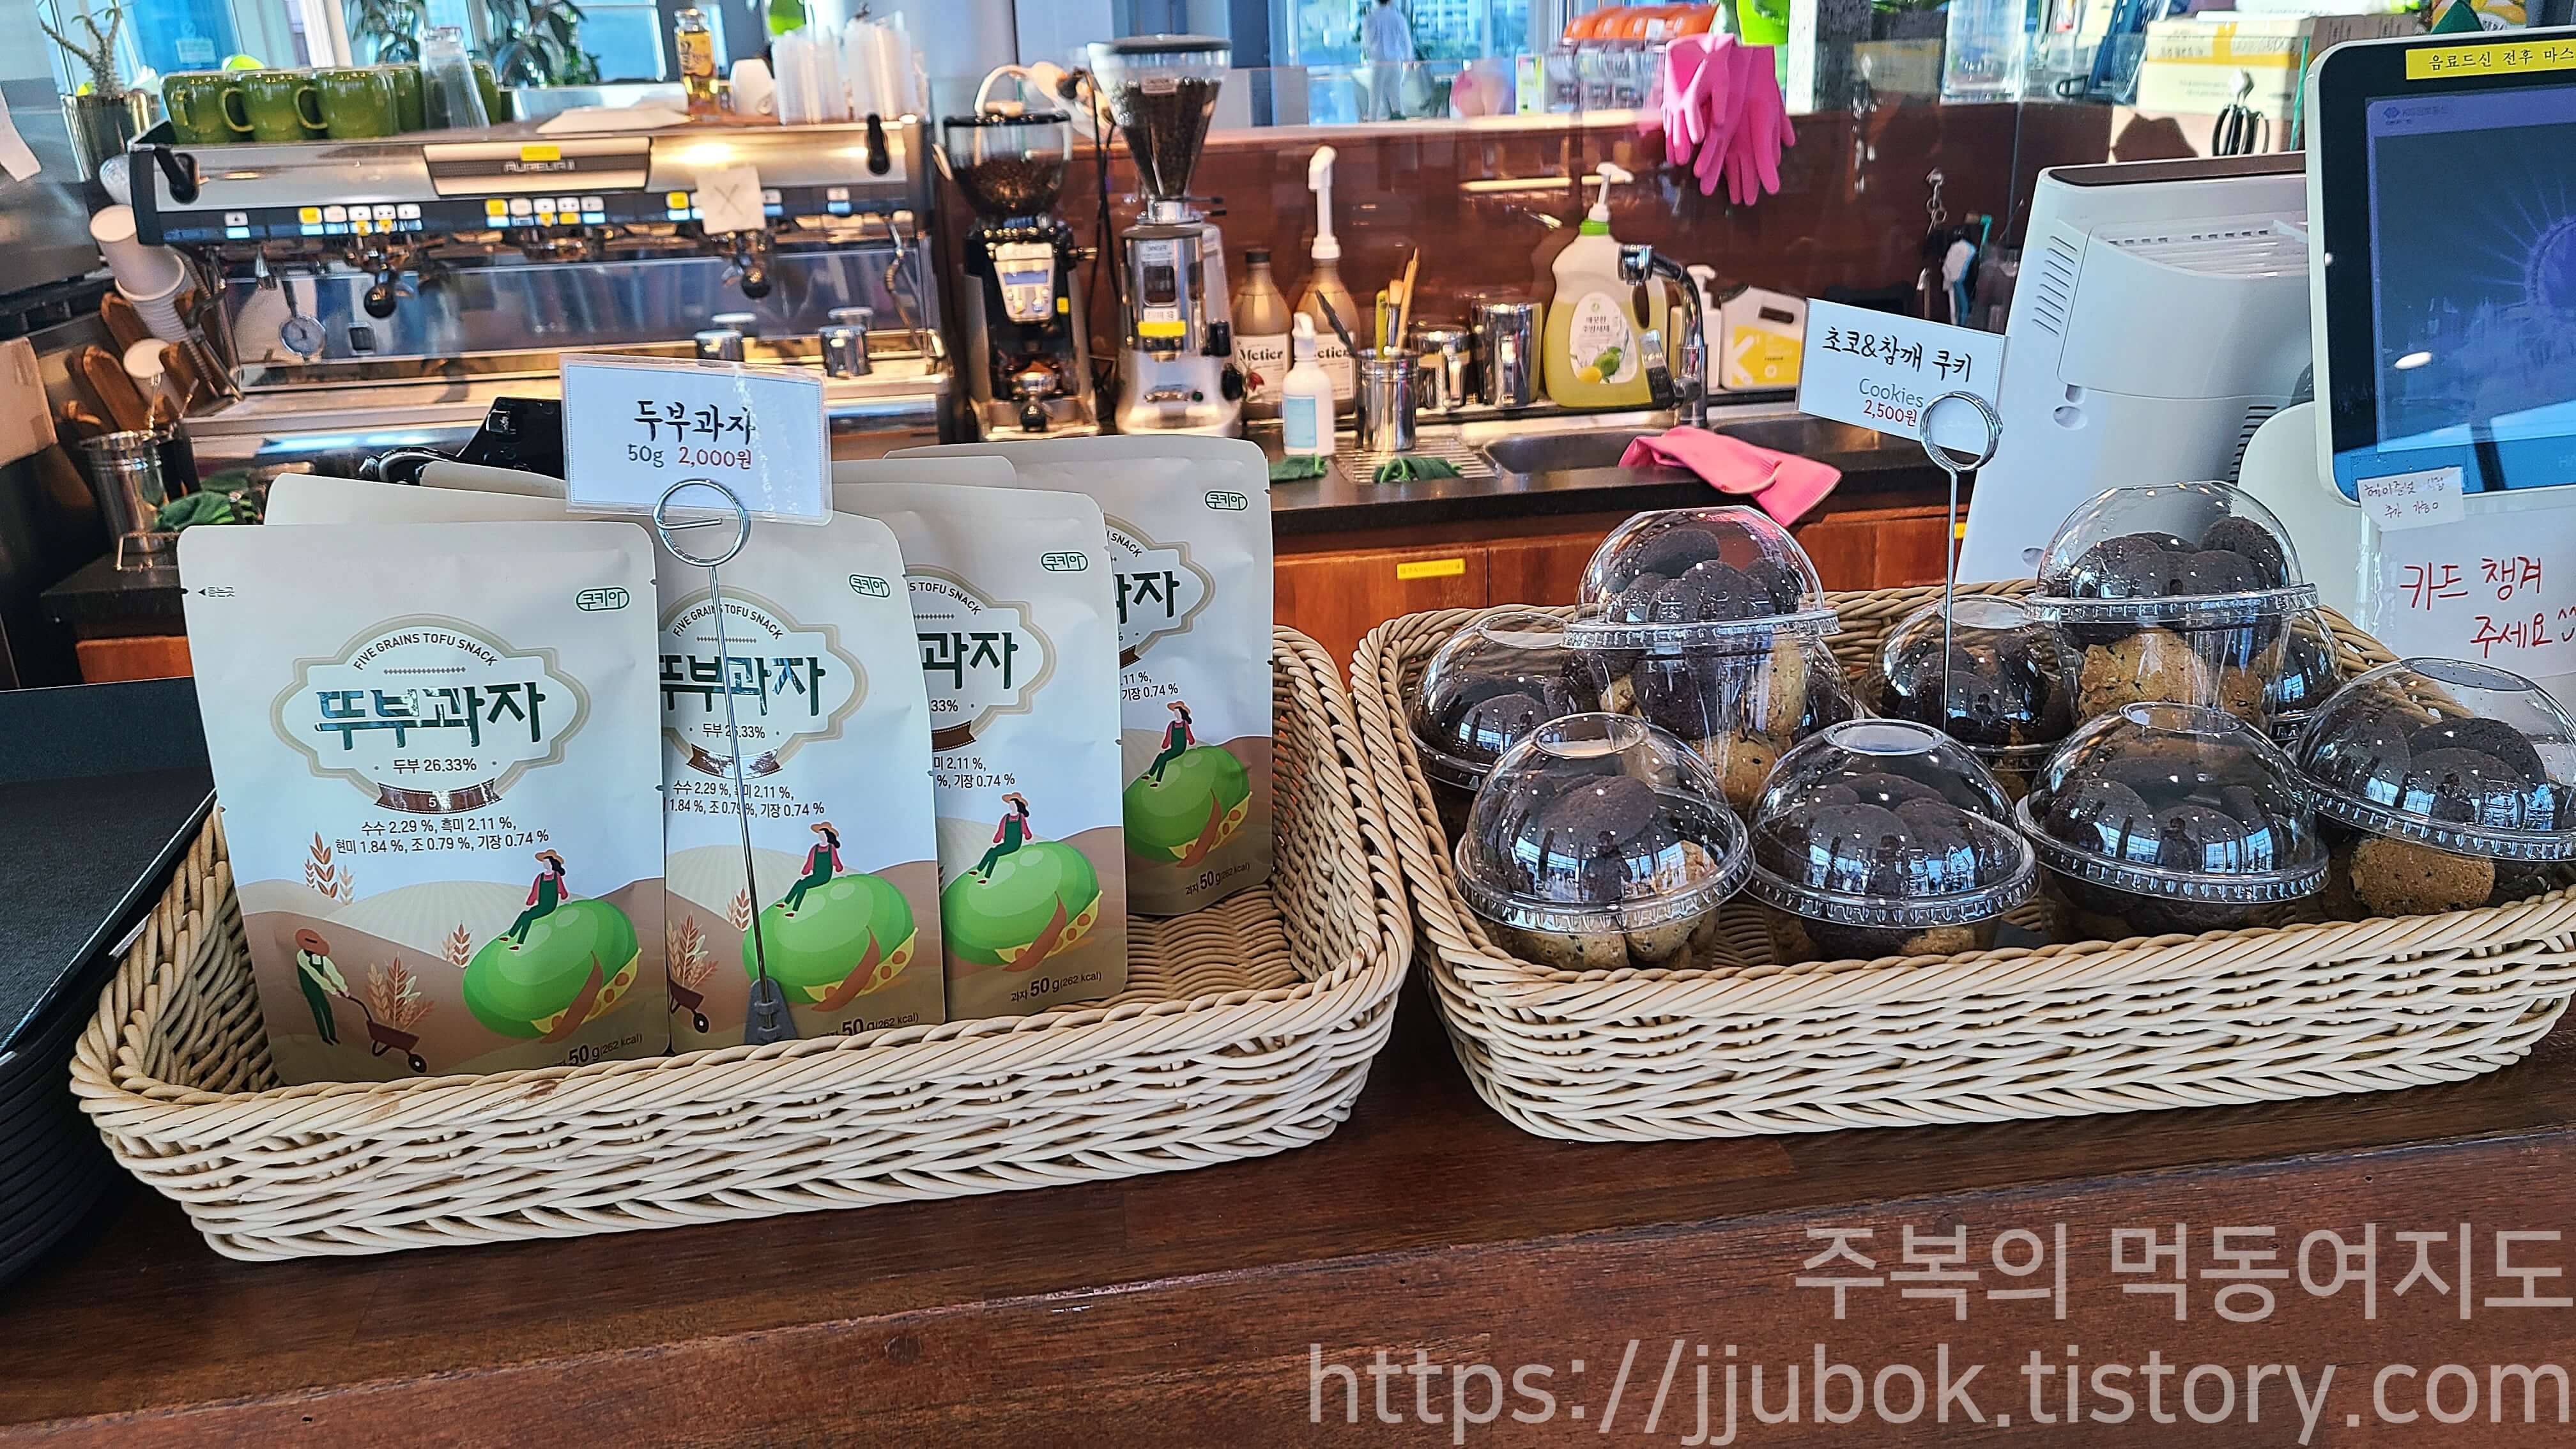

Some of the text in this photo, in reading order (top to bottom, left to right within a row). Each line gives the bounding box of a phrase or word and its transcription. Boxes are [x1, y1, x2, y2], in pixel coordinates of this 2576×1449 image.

[2428, 47, 2574, 71] 음료드신 전후 마스
[1239, 348, 1284, 362] Metier
[1822, 326, 1923, 372] 초코&참깨
[1932, 349, 1972, 383] 쿠키
[1859, 378, 1924, 408] Cookies
[633, 400, 756, 445] 두부과자
[1863, 399, 1917, 427] 2,500원
[627, 443, 752, 470] 50g 2,000원
[1110, 532, 1143, 558] SNACK
[2400, 556, 2542, 611] 카드 챙겨
[576, 586, 631, 612] 쿠키아
[918, 582, 947, 594] TOFU
[948, 588, 982, 615] SNACK
[673, 615, 692, 637] FIVE
[724, 604, 749, 617] TOFU
[749, 611, 784, 640] SNACK
[2469, 612, 2554, 659] 주세요
[353, 633, 498, 671] FIVE GRAINS TOFU SNACK
[917, 632, 1019, 690] 과자
[1121, 682, 1179, 702] 기장 0.74 %
[930, 699, 959, 712] 33%
[702, 723, 723, 738] 두부
[392, 758, 477, 774] 두부 26.33%
[933, 756, 944, 770] 미
[947, 757, 969, 769] 2.11
[673, 780, 693, 795] 수수
[694, 782, 716, 795] 2.29
[754, 785, 775, 799] 2.11
[954, 774, 974, 789] 기장
[976, 774, 1001, 788] 0.74
[1004, 773, 1015, 786] %
[670, 799, 691, 812] 1.84
[709, 801, 719, 814] 조
[760, 804, 781, 818] 기장
[783, 804, 810, 817] 0.74
[813, 801, 825, 815] %
[361, 820, 386, 836] 수수
[388, 820, 417, 834] 2.29
[440, 817, 464, 833] 흑미
[467, 817, 495, 831] 2.11
[335, 838, 356, 854] 현미
[360, 839, 387, 854] 1.84
[411, 838, 424, 851] 조
[426, 836, 454, 851] 0.79
[478, 834, 502, 850] 기장
[505, 832, 533, 847] 0.74
[536, 829, 549, 843] %
[1200, 870, 1214, 890] 50
[1011, 990, 1028, 1002] 과자
[1030, 977, 1050, 997] 50
[841, 1018, 864, 1036] 50
[569, 1044, 589, 1066] 50
